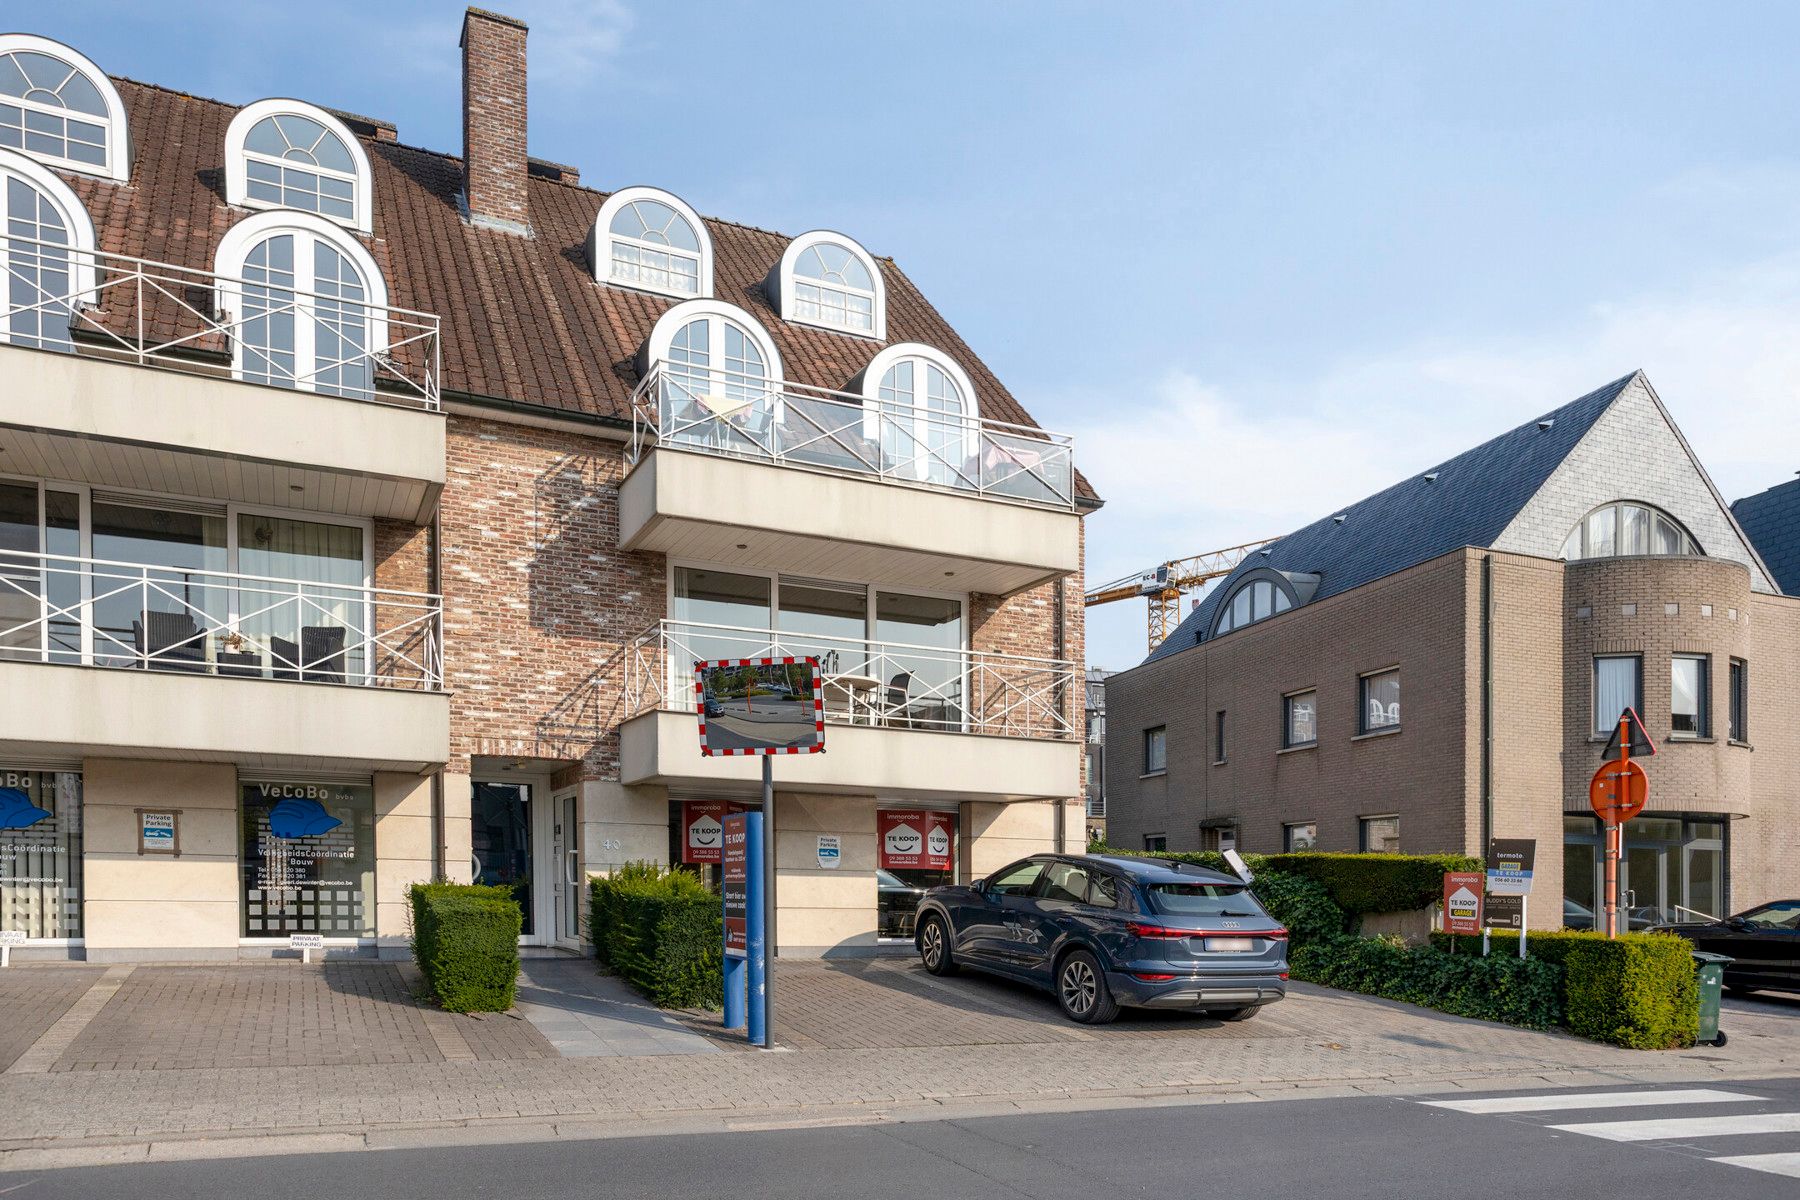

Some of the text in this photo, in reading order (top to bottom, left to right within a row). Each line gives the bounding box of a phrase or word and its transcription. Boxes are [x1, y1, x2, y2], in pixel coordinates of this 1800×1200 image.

[259, 783, 328, 799] VeCoBo
[725, 832, 746, 844] TE KOOP
[290, 858, 314, 866] Bouw
[1514, 916, 1519, 924] P
